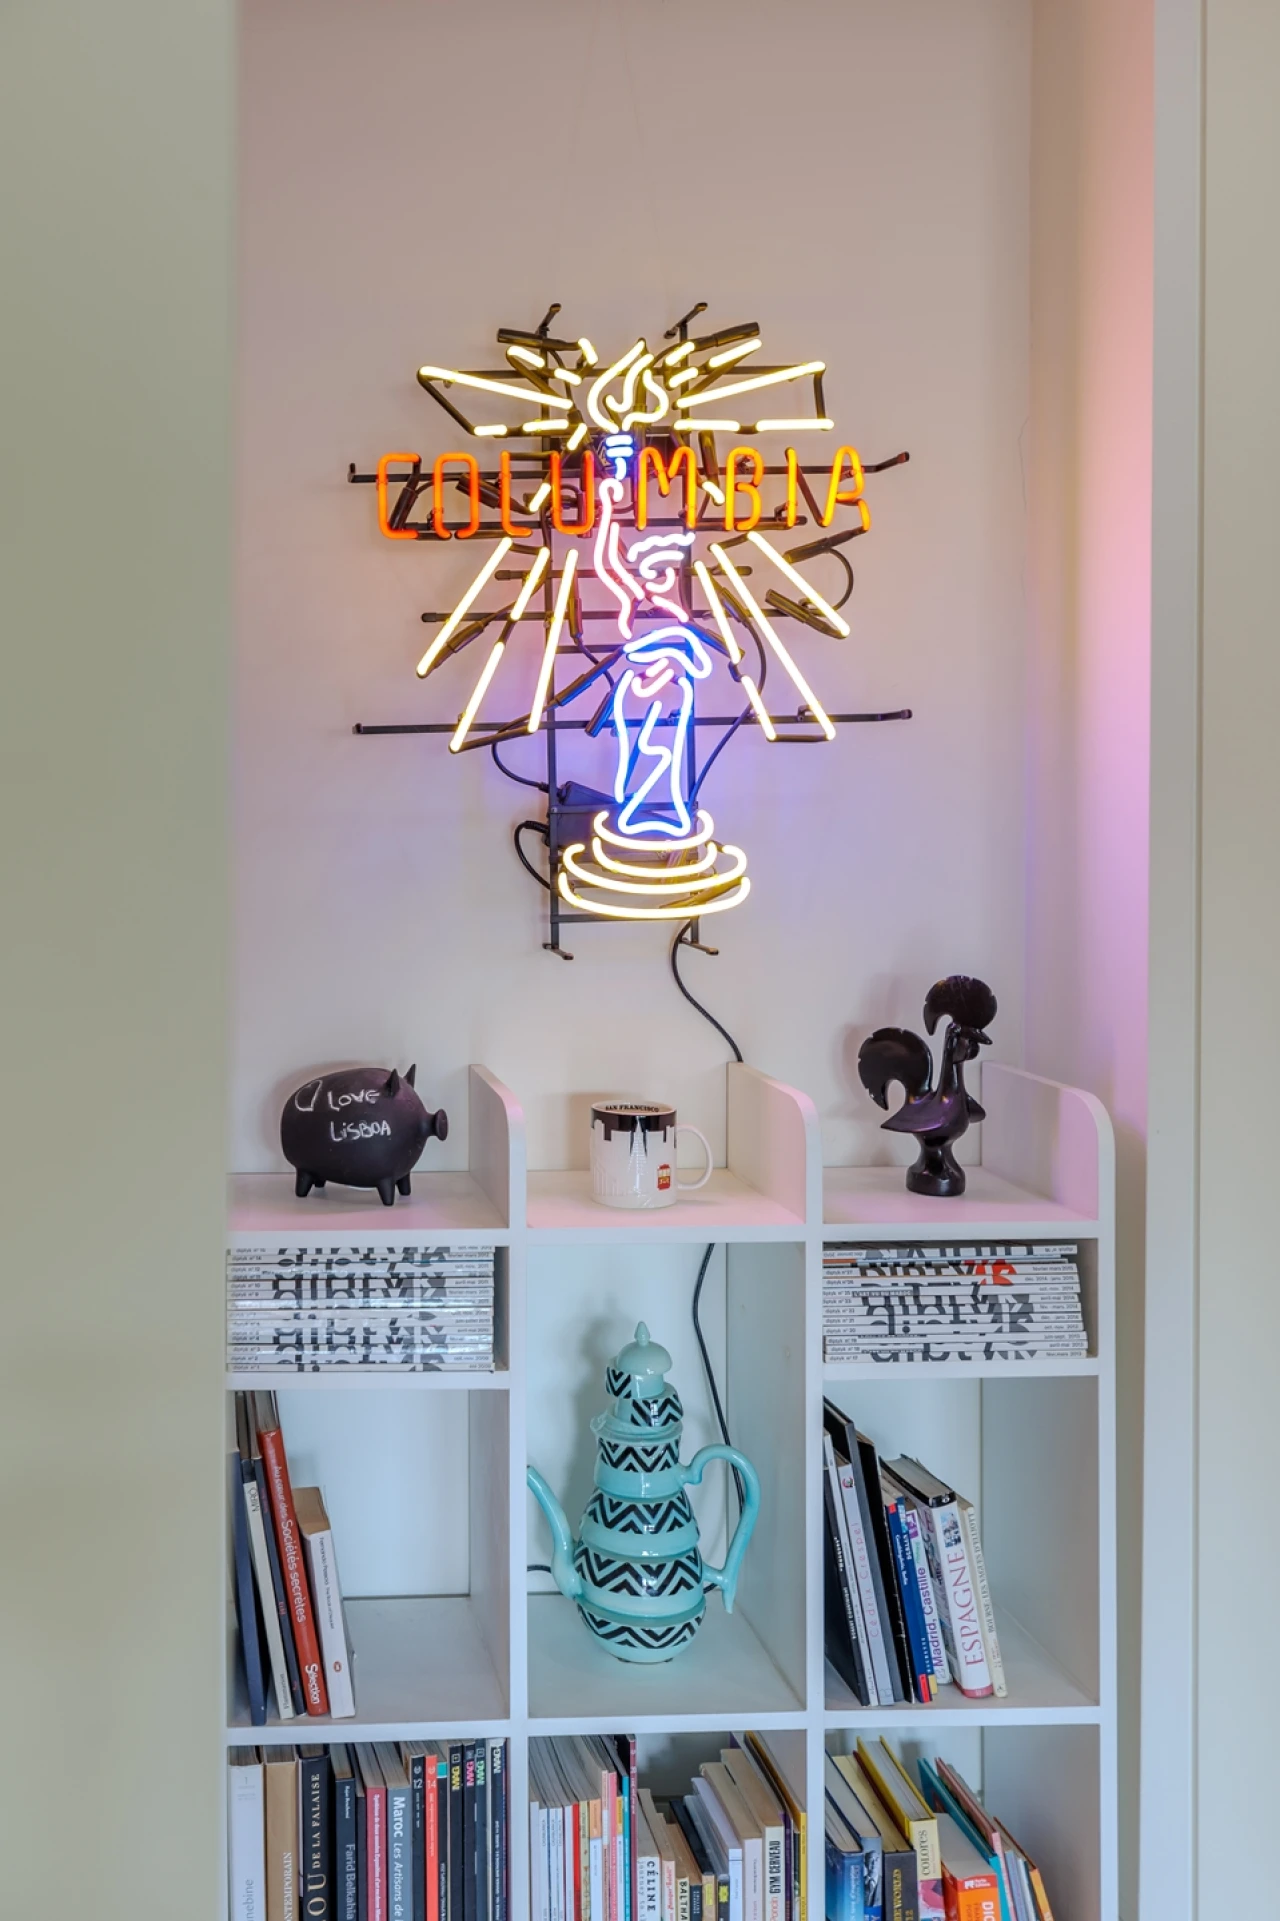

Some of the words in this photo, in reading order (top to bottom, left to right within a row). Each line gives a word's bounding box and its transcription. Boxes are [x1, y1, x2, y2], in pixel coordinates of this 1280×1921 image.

[377, 446, 871, 539] COLUMBIA
[327, 1089, 380, 1112] LOVE
[619, 1104, 659, 1112] FRANCISCO
[280, 1501, 289, 1519] des
[282, 1519, 300, 1571] Sociétés
[851, 1522, 869, 1580] Crespel
[290, 1572, 307, 1623] secrètes
[917, 1567, 935, 1616] Castille
[947, 1551, 984, 1666] ESPAGNE
[926, 1619, 944, 1667] Madrid,
[305, 1663, 321, 1705] Sélection
[451, 1765, 461, 1791] MAG
[466, 1760, 475, 1787] MAG
[476, 1760, 485, 1786] MAG
[493, 1748, 502, 1774] MAG
[311, 1773, 321, 1828] FALAISE
[413, 1779, 423, 1789] 12
[427, 1780, 437, 1789] 14
[393, 1796, 406, 1838] Maroc
[312, 1831, 321, 1848] LA
[393, 1843, 403, 1859] Les
[769, 1840, 781, 1874] CERVEAU
[311, 1852, 321, 1869] DE
[346, 1843, 356, 1872] Farid
[394, 1861, 404, 1902] Artisans
[638, 1860, 646, 1896] journey
[647, 1860, 659, 1912] CÉLINE
[769, 1875, 781, 1894] GYM
[892, 1868, 902, 1909] WORLD
[307, 1872, 327, 1921] OU
[346, 1873, 357, 1921] Belkahia
[394, 1904, 404, 1917] de
